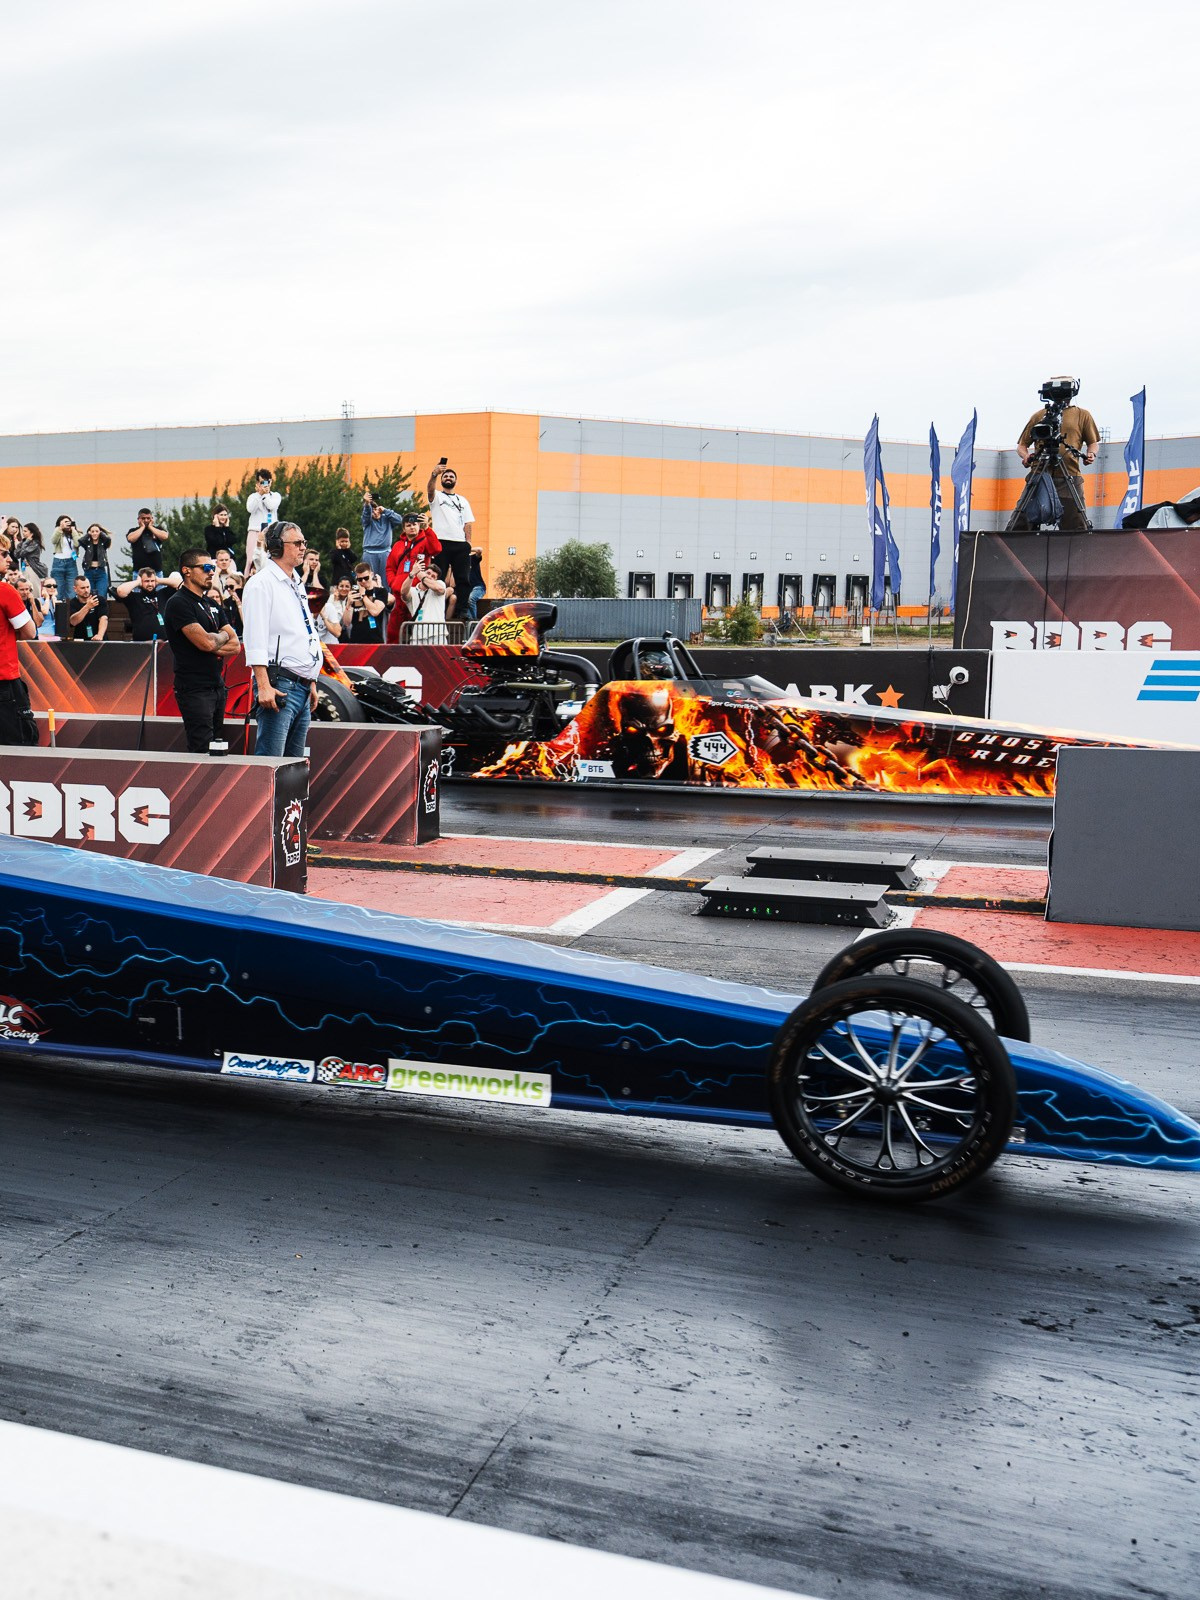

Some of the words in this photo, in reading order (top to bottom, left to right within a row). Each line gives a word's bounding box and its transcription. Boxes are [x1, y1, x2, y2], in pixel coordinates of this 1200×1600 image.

[484, 618, 526, 634] GHOST
[485, 629, 524, 646] RIDER
[703, 742, 727, 753] 444
[956, 731, 1069, 754] GHOST
[971, 749, 1056, 769] RIDE
[587, 764, 604, 774] ВТБ
[338, 1063, 386, 1082] ARC
[391, 1067, 544, 1100] greenworks
